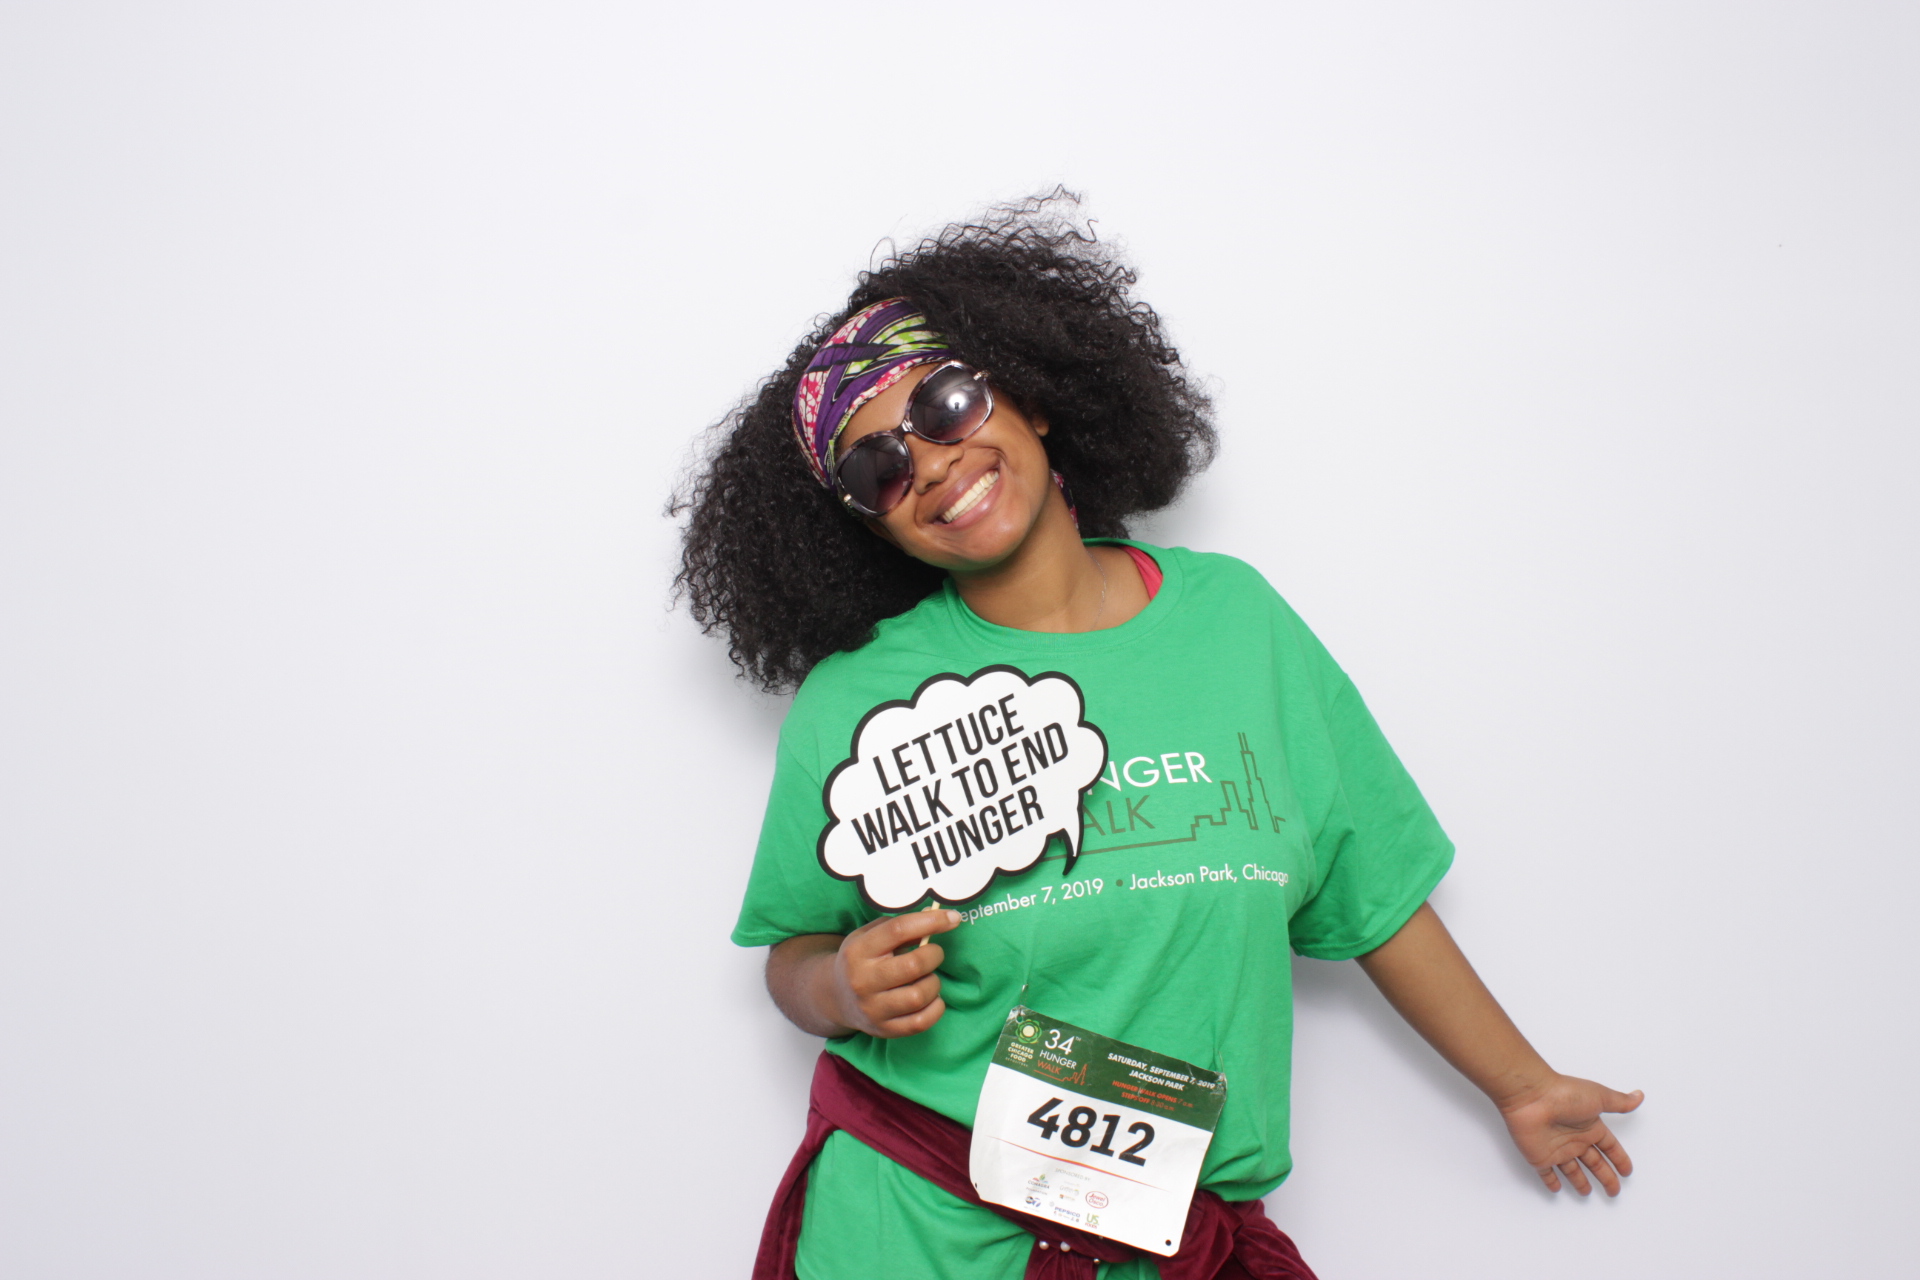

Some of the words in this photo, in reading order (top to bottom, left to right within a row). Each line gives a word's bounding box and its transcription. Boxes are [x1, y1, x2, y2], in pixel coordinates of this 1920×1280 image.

[872, 693, 1024, 796] LETTUCE
[1087, 751, 1213, 795] NGER
[851, 779, 953, 855] WALK
[951, 758, 999, 807] TO
[1001, 722, 1069, 785] END
[911, 785, 1044, 880] HUNGER
[1060, 795, 1156, 842] ALK
[953, 893, 1036, 925] eptember
[1041, 886, 1056, 905] 7,
[1061, 878, 1104, 900] 2019
[1129, 870, 1195, 890] Jackson
[1199, 863, 1237, 883] Park,
[1242, 863, 1289, 887] Chicago
[1008, 1047, 1033, 1060] CHICAGO
[1010, 1054, 1027, 1062] FOOD
[1011, 1042, 1034, 1054] GREATER
[1039, 1050, 1077, 1070] HUNGER
[1037, 1060, 1062, 1075] WALK
[1108, 1053, 1147, 1071] SATURDAY,
[1149, 1066, 1190, 1082] SEPTEMBER
[1197, 1080, 1216, 1089] 2019
[1129, 1070, 1165, 1086] JACKSON
[1165, 1080, 1185, 1091] PARK
[1112, 1080, 1139, 1092] HUNGER
[1138, 1088, 1157, 1098] WALK
[1157, 1093, 1177, 1103] OPENS
[1027, 1097, 1155, 1167] 4812
[1055, 1206, 1081, 1218] PEPSICO
